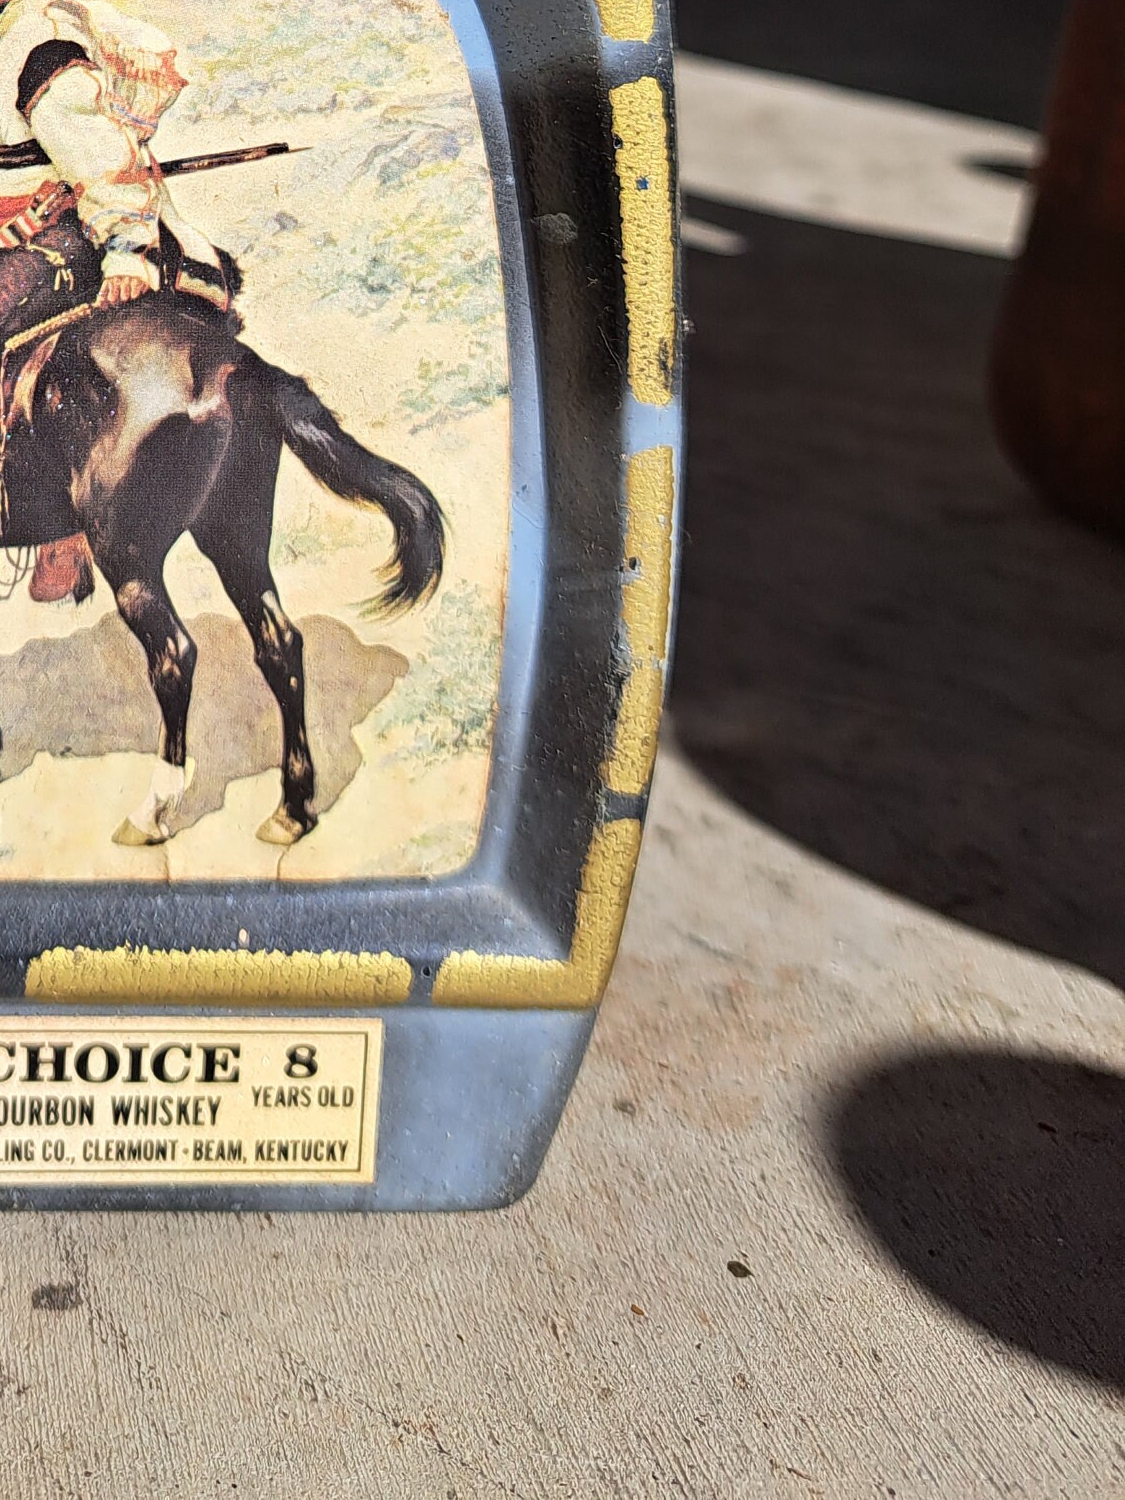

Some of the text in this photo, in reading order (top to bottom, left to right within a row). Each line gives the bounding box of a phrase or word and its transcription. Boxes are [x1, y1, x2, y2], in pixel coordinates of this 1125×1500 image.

[283, 1042, 319, 1079] 8
[110, 1094, 222, 1127] WHISKEY
[251, 1084, 355, 1108] YEARS OLD
[254, 1138, 349, 1163] KENTUCKY
